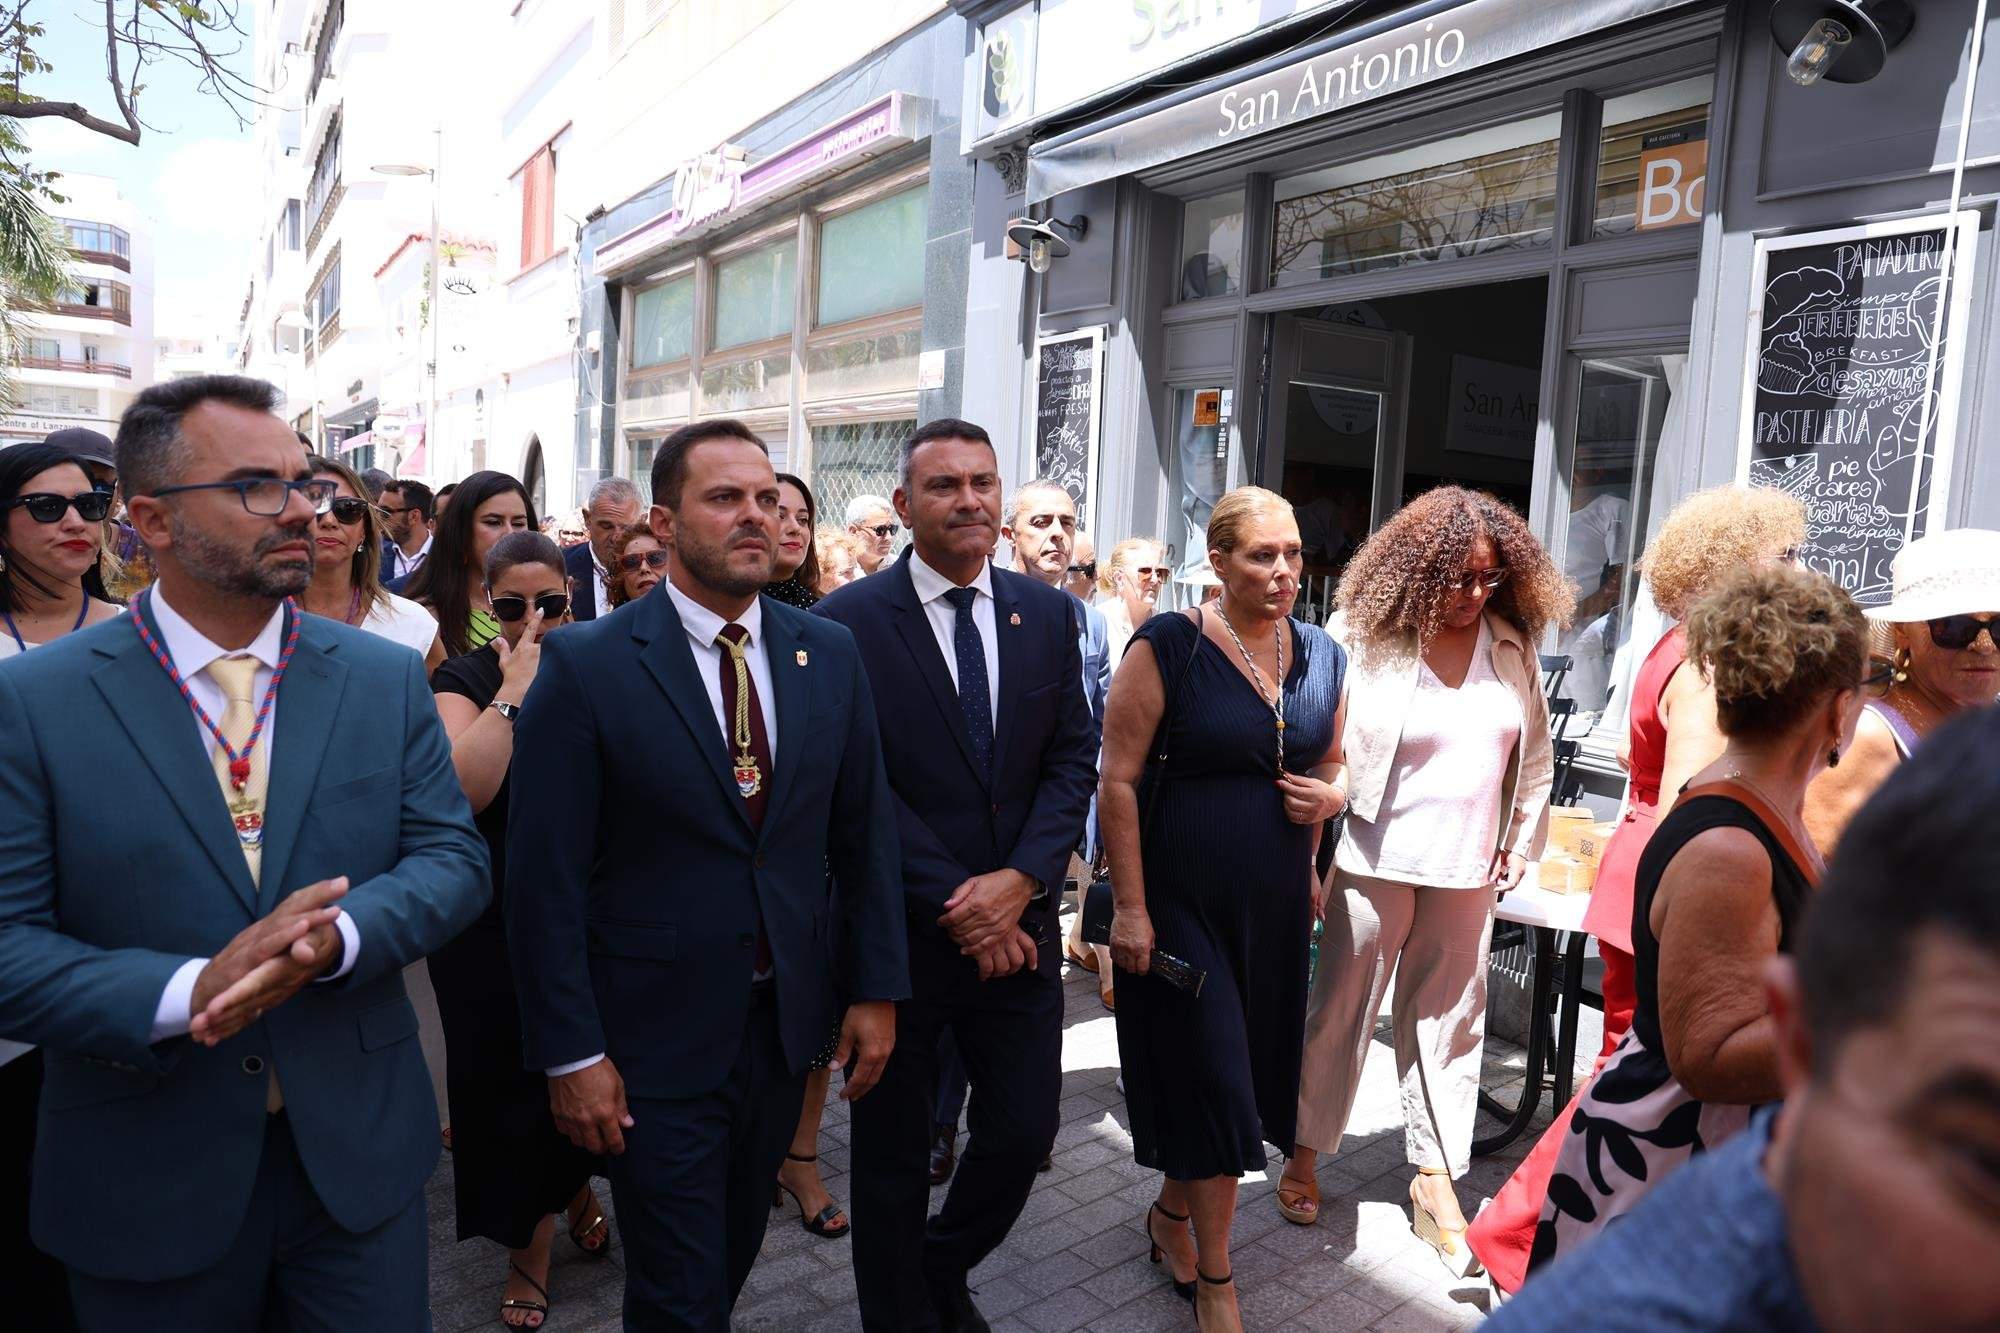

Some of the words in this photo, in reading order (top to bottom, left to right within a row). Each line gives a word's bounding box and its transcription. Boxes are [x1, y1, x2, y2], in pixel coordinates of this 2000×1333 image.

[1218, 88, 1278, 138] San
[1291, 22, 1465, 114] Antonio
[1806, 311, 1906, 329] FRESCOS
[1814, 346, 1904, 363] BREKFAST
[1060, 402, 1089, 416] FRESH
[1464, 381, 1502, 418] San
[31, 421, 39, 430] of
[1756, 402, 1871, 445] PASTELERÍA
[1828, 456, 1860, 480] pie
[1806, 497, 1889, 527] tartas
